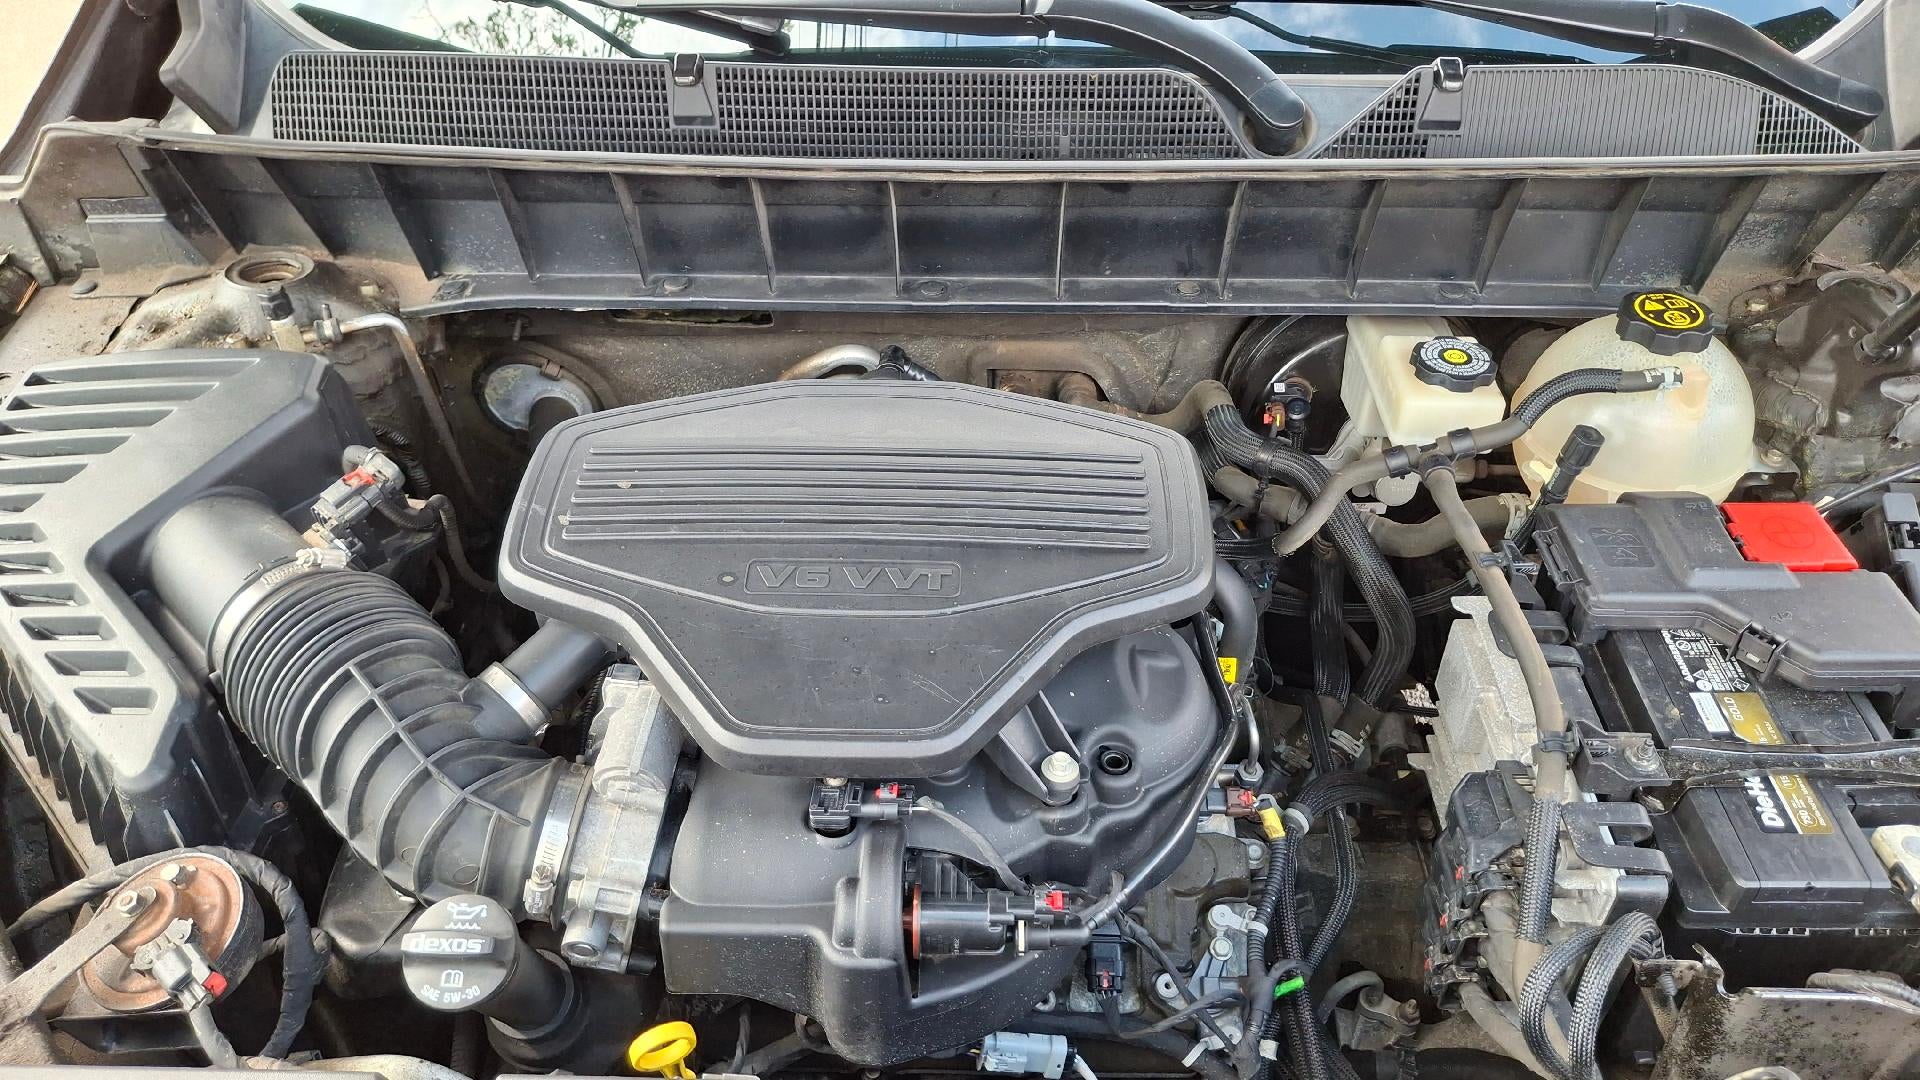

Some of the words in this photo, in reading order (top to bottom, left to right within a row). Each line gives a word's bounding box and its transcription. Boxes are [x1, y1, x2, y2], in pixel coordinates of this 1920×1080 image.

[756, 565, 830, 588] V6
[843, 567, 953, 591] VVT
[1723, 697, 1744, 721] GOLD
[409, 934, 482, 953] dexos
[421, 985, 440, 1002] SAE
[443, 985, 481, 1003] 5W-30
